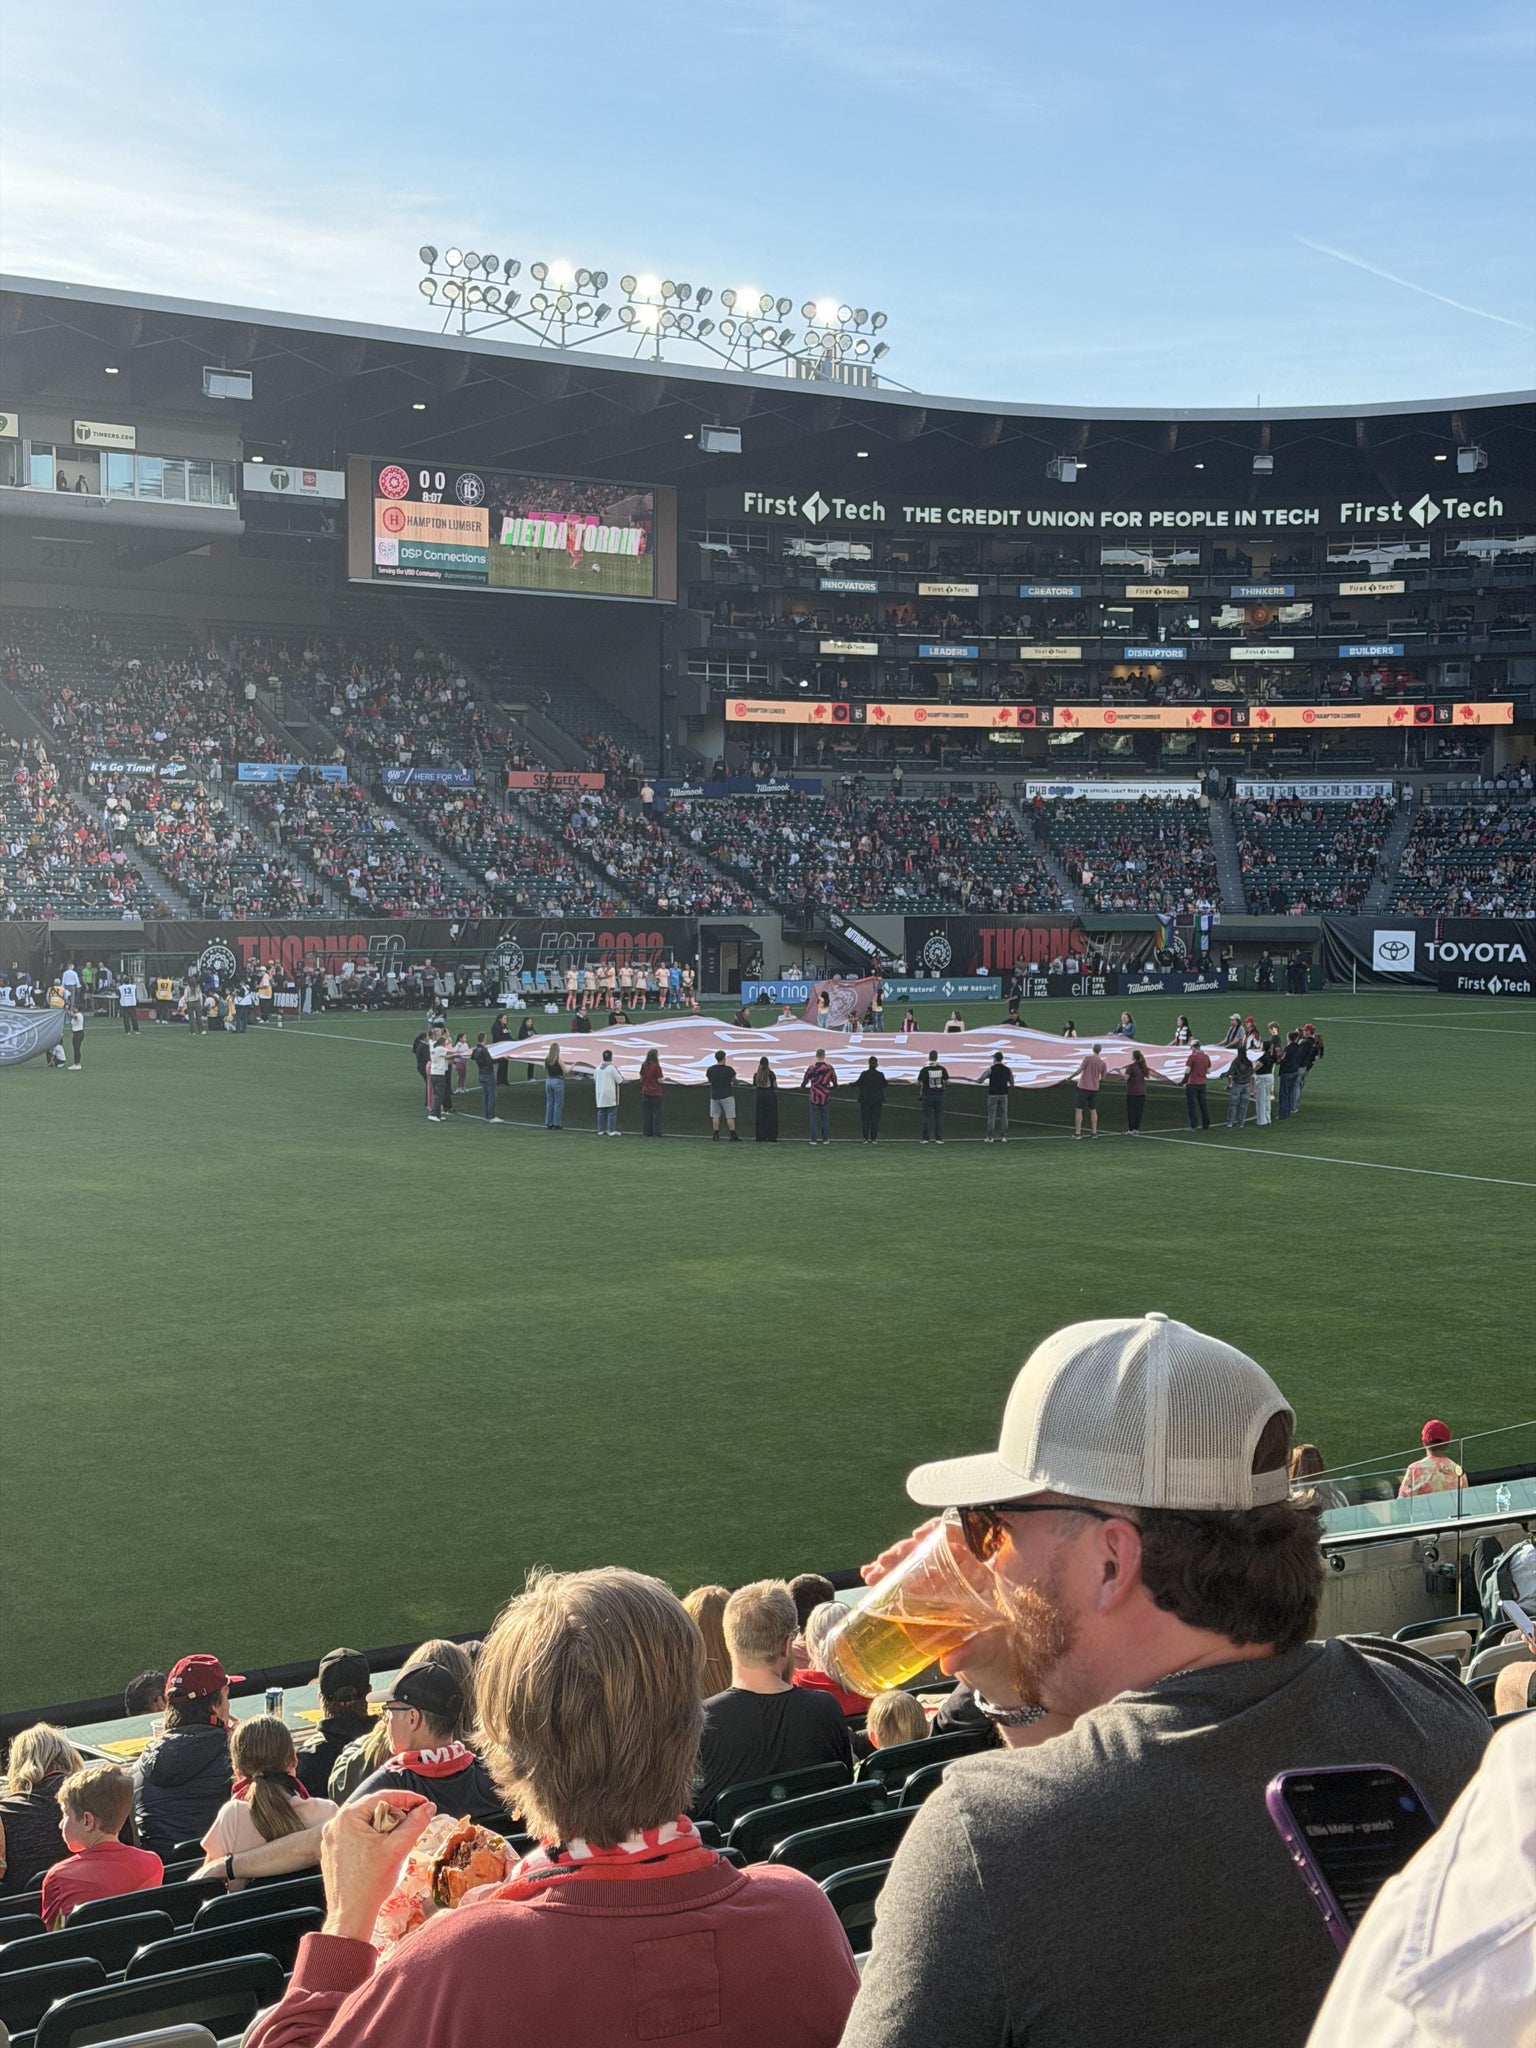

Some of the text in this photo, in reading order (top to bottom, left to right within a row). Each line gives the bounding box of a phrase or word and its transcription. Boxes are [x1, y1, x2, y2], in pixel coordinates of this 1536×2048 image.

[419, 470, 446, 490] 0 0
[422, 491, 443, 503] 8:07
[744, 491, 886, 521] First Tech
[1340, 496, 1503, 524] First Tech
[407, 515, 482, 533] HAMPTON LUMBER
[902, 506, 1320, 528] THE CREDIT UNION FOR PEOPLE IN TECH
[401, 547, 486, 564] DSP Connections
[822, 580, 876, 591] INNOVATORS
[1028, 587, 1074, 596] CREATORS
[1240, 587, 1285, 596] THINKERS
[929, 647, 968, 656] LEADERS
[1127, 649, 1184, 658] DISRUPTORS
[1349, 646, 1394, 656] BUILDERS
[90, 761, 156, 773] It's Go Time!
[414, 773, 434, 781] HERE
[437, 773, 453, 781] FOR
[668, 786, 704, 797] Tillamook
[755, 782, 790, 794] Tillamook
[1029, 785, 1047, 795] PUB
[844, 926, 877, 955] AUTOGRAPH
[1424, 942, 1527, 963] TOYOTA
[123, 987, 132, 995] 13
[1071, 976, 1091, 996] elf
[1127, 980, 1164, 994] Tillamook
[1183, 979, 1219, 993] Tillamook
[1457, 976, 1531, 992] First Tech
[781, 982, 808, 1002] ring
[273, 991, 299, 1008] THORNS
